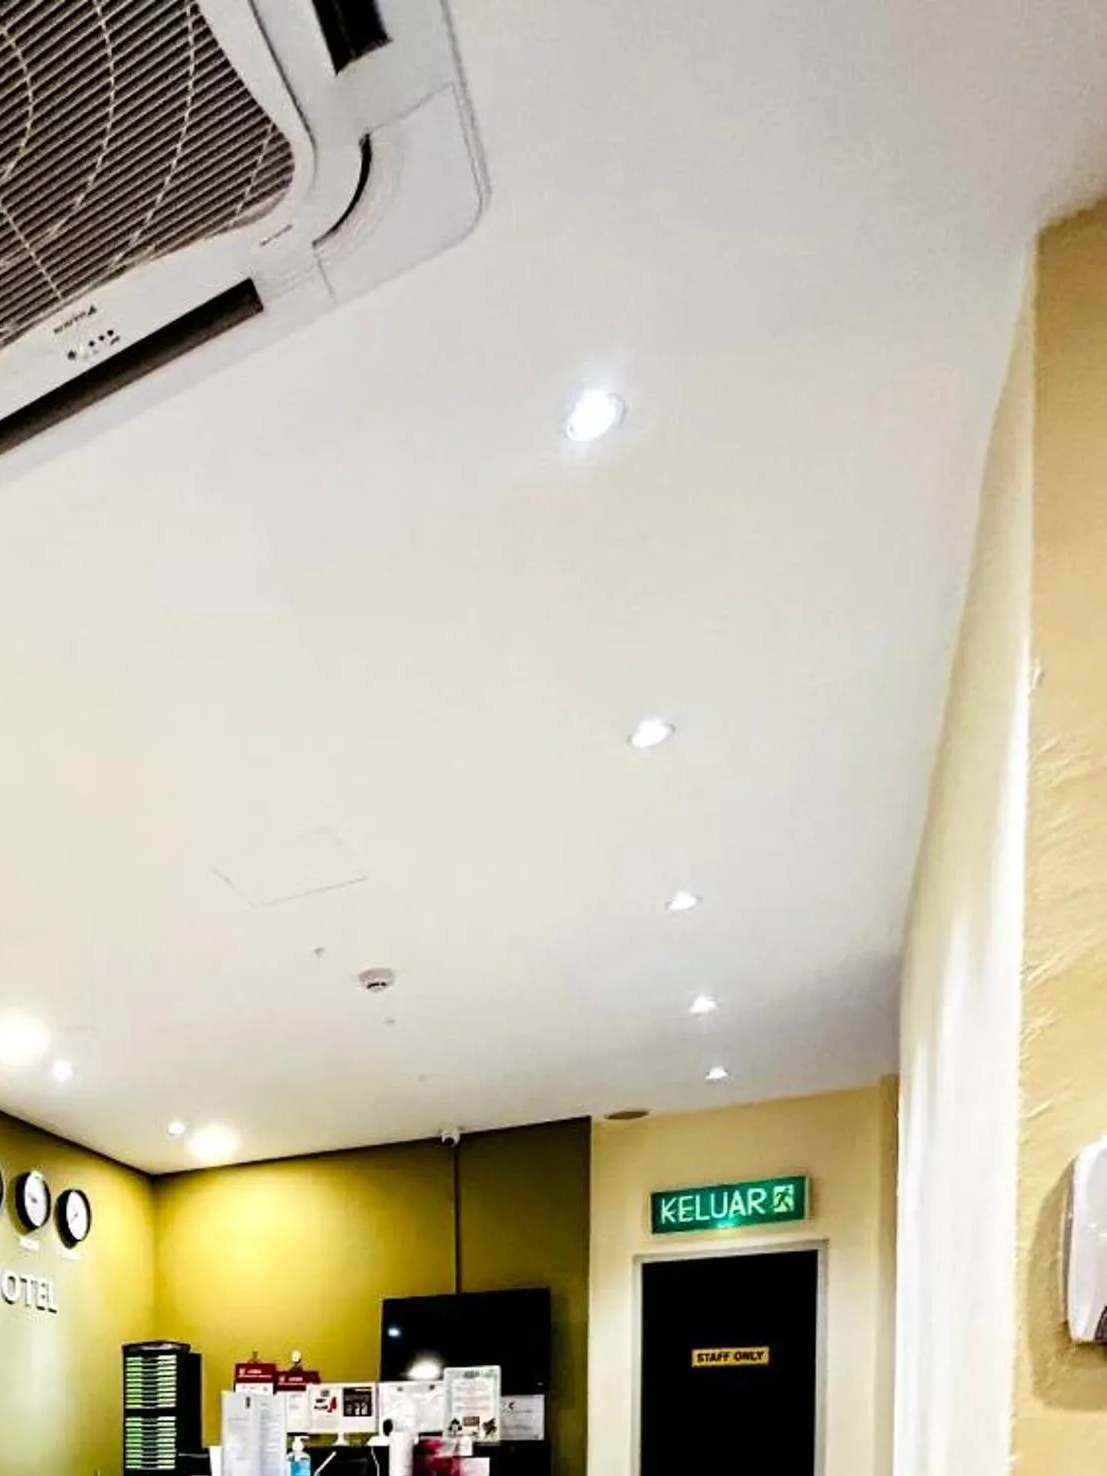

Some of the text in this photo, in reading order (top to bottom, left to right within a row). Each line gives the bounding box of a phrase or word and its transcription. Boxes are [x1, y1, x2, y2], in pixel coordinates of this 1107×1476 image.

[660, 1187, 767, 1224] KELUAR
[696, 1350, 765, 1364] STAFF ONLY
